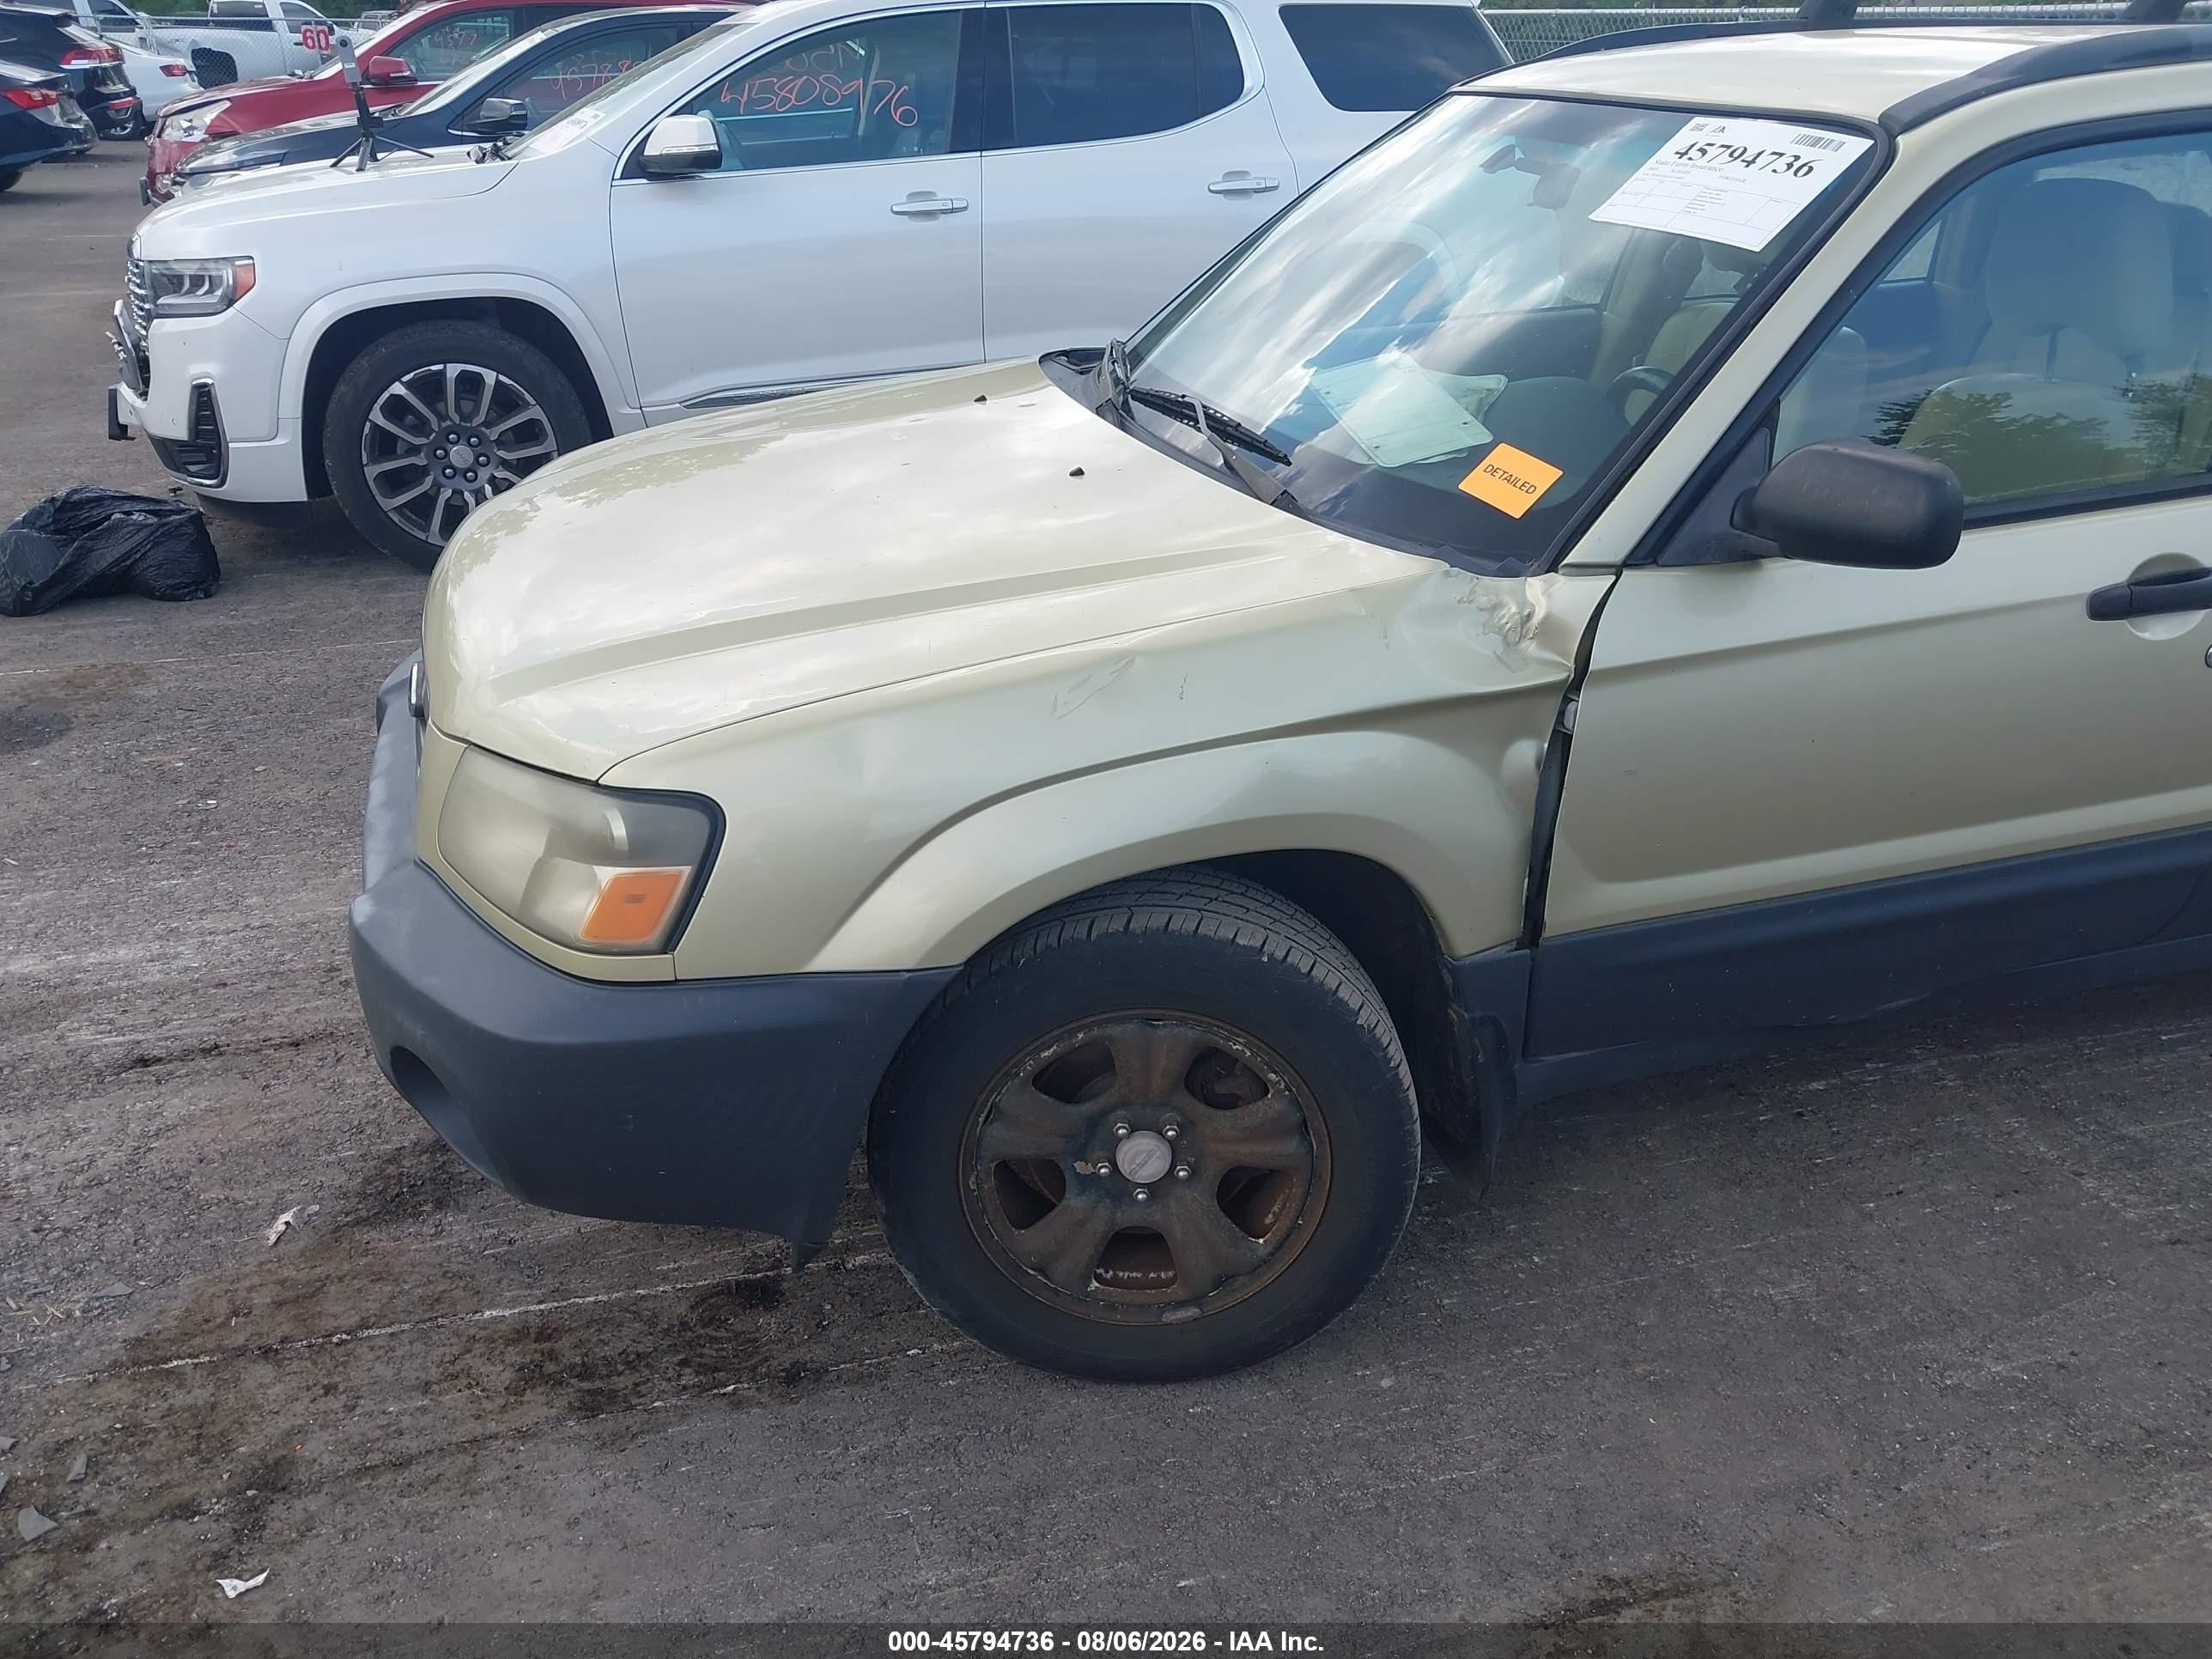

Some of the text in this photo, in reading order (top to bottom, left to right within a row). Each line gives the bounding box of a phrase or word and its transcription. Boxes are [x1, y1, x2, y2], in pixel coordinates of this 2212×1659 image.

[301, 27, 331, 52] 60
[720, 74, 918, 126] 45808976
[1673, 140, 1826, 179] 45794736
[1483, 464, 1537, 495] DETAILED
